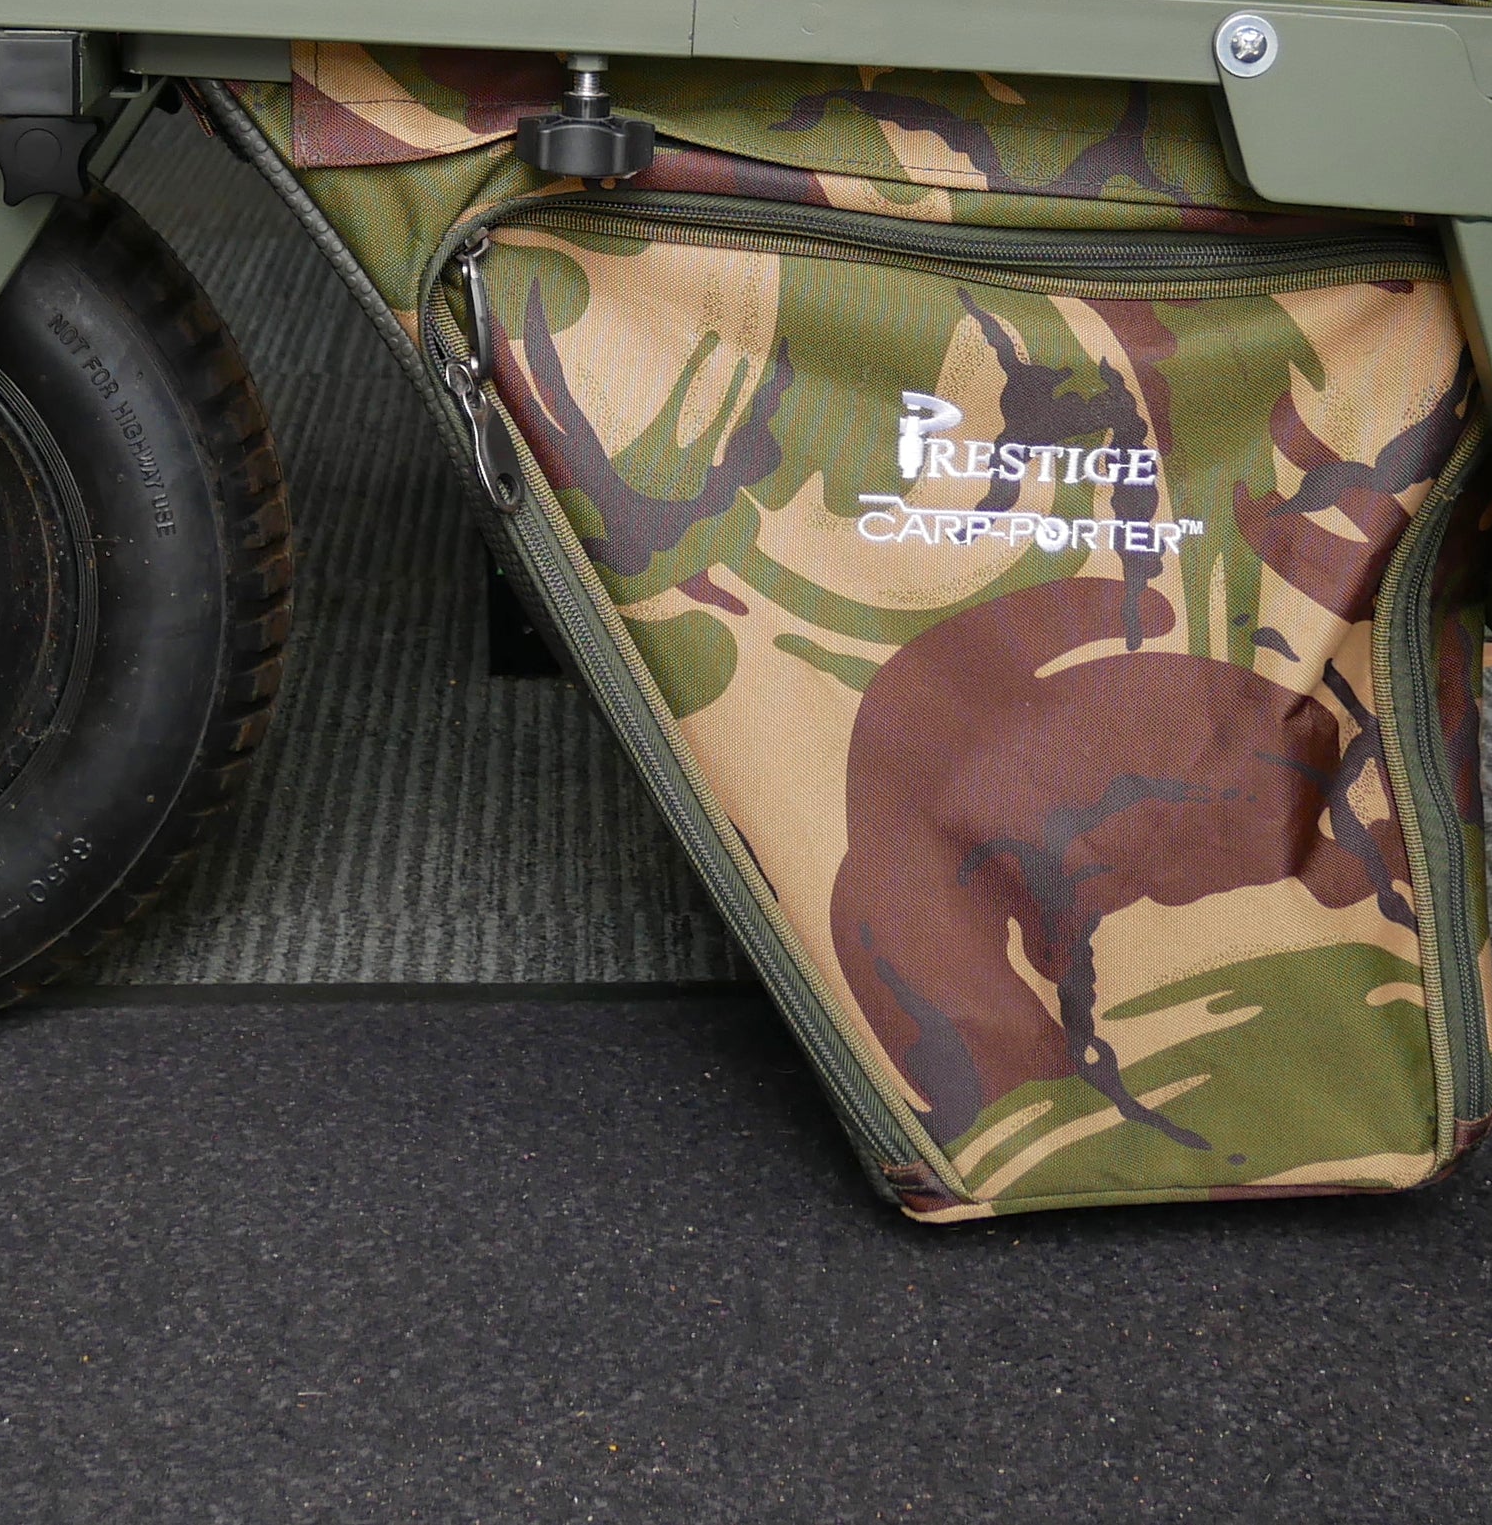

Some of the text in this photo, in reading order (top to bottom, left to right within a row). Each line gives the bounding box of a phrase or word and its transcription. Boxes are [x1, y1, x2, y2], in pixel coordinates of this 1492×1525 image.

[47, 312, 177, 538] NOT FOR HIGHWAY USE
[898, 390, 1158, 486] PRESTIGE
